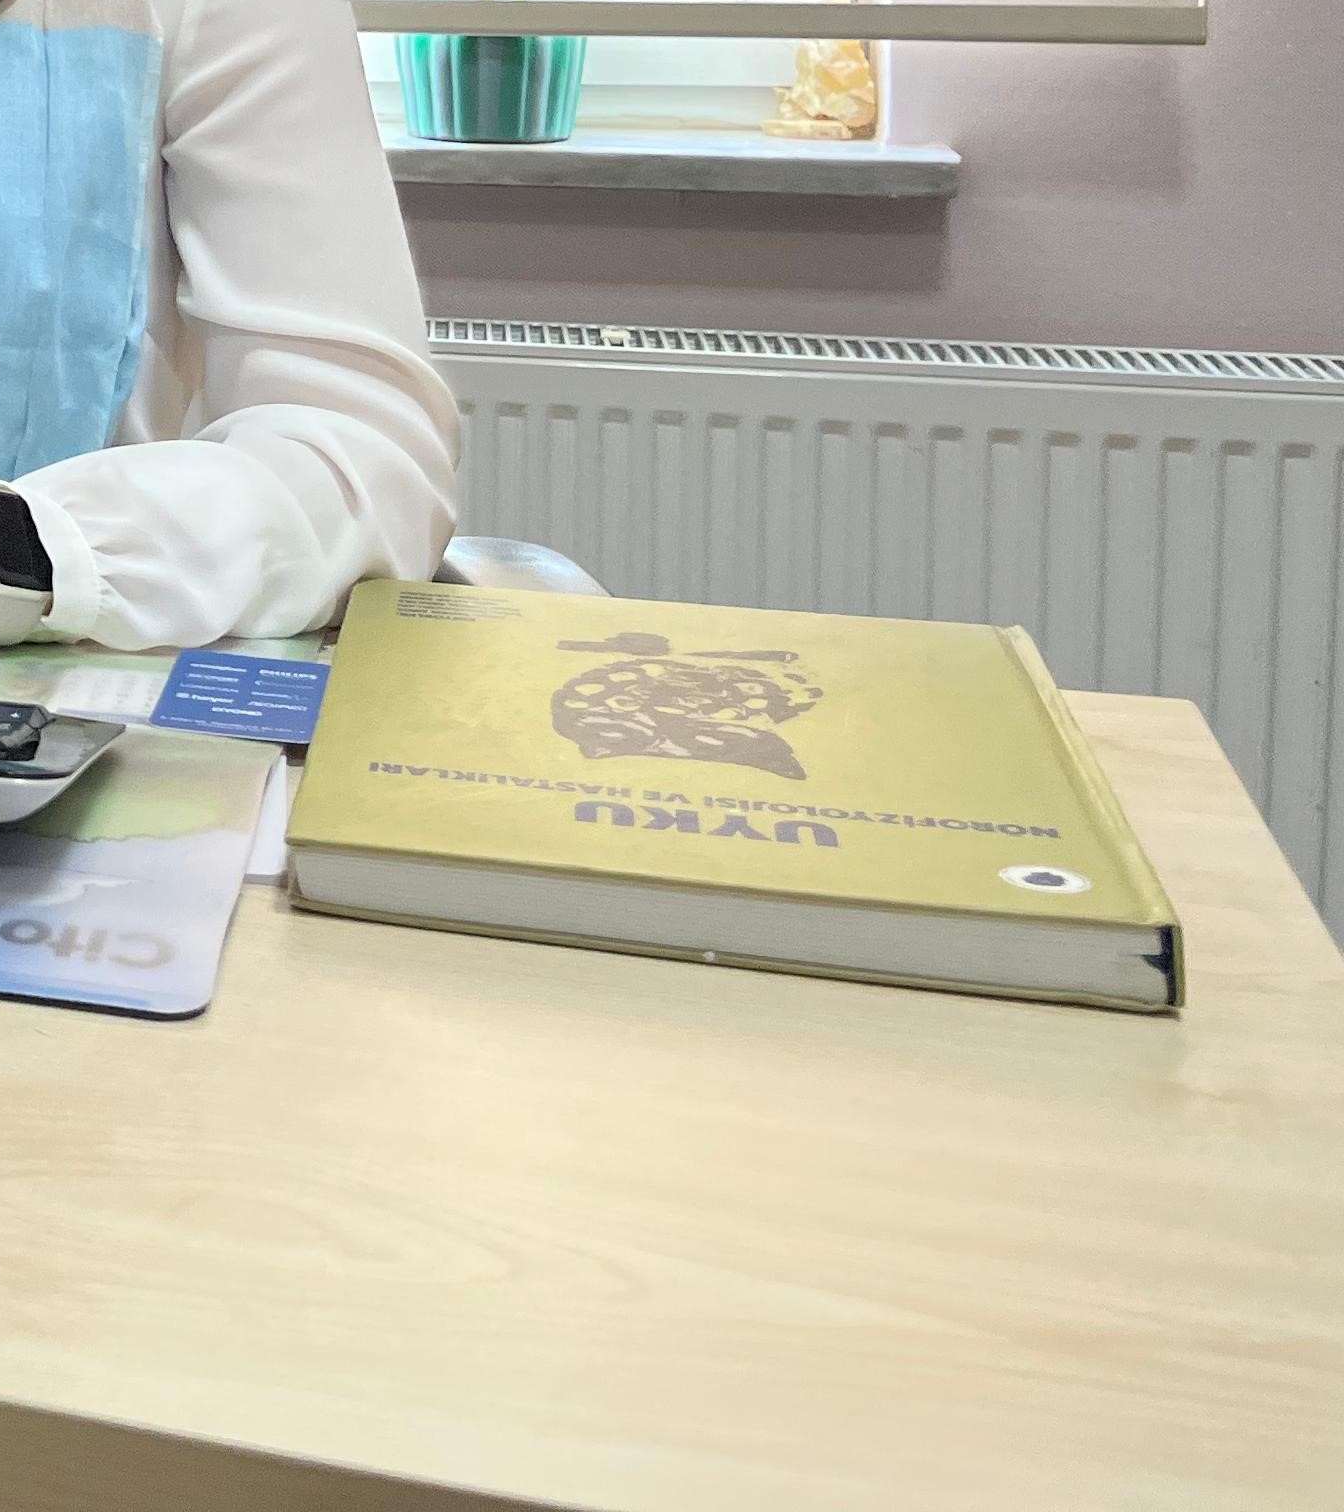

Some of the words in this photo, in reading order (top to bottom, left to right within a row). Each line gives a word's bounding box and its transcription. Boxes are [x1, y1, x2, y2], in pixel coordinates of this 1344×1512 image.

[368, 760, 633, 798] HASTALIKLARI
[641, 787, 689, 804] VE
[573, 801, 841, 849] UYKU
